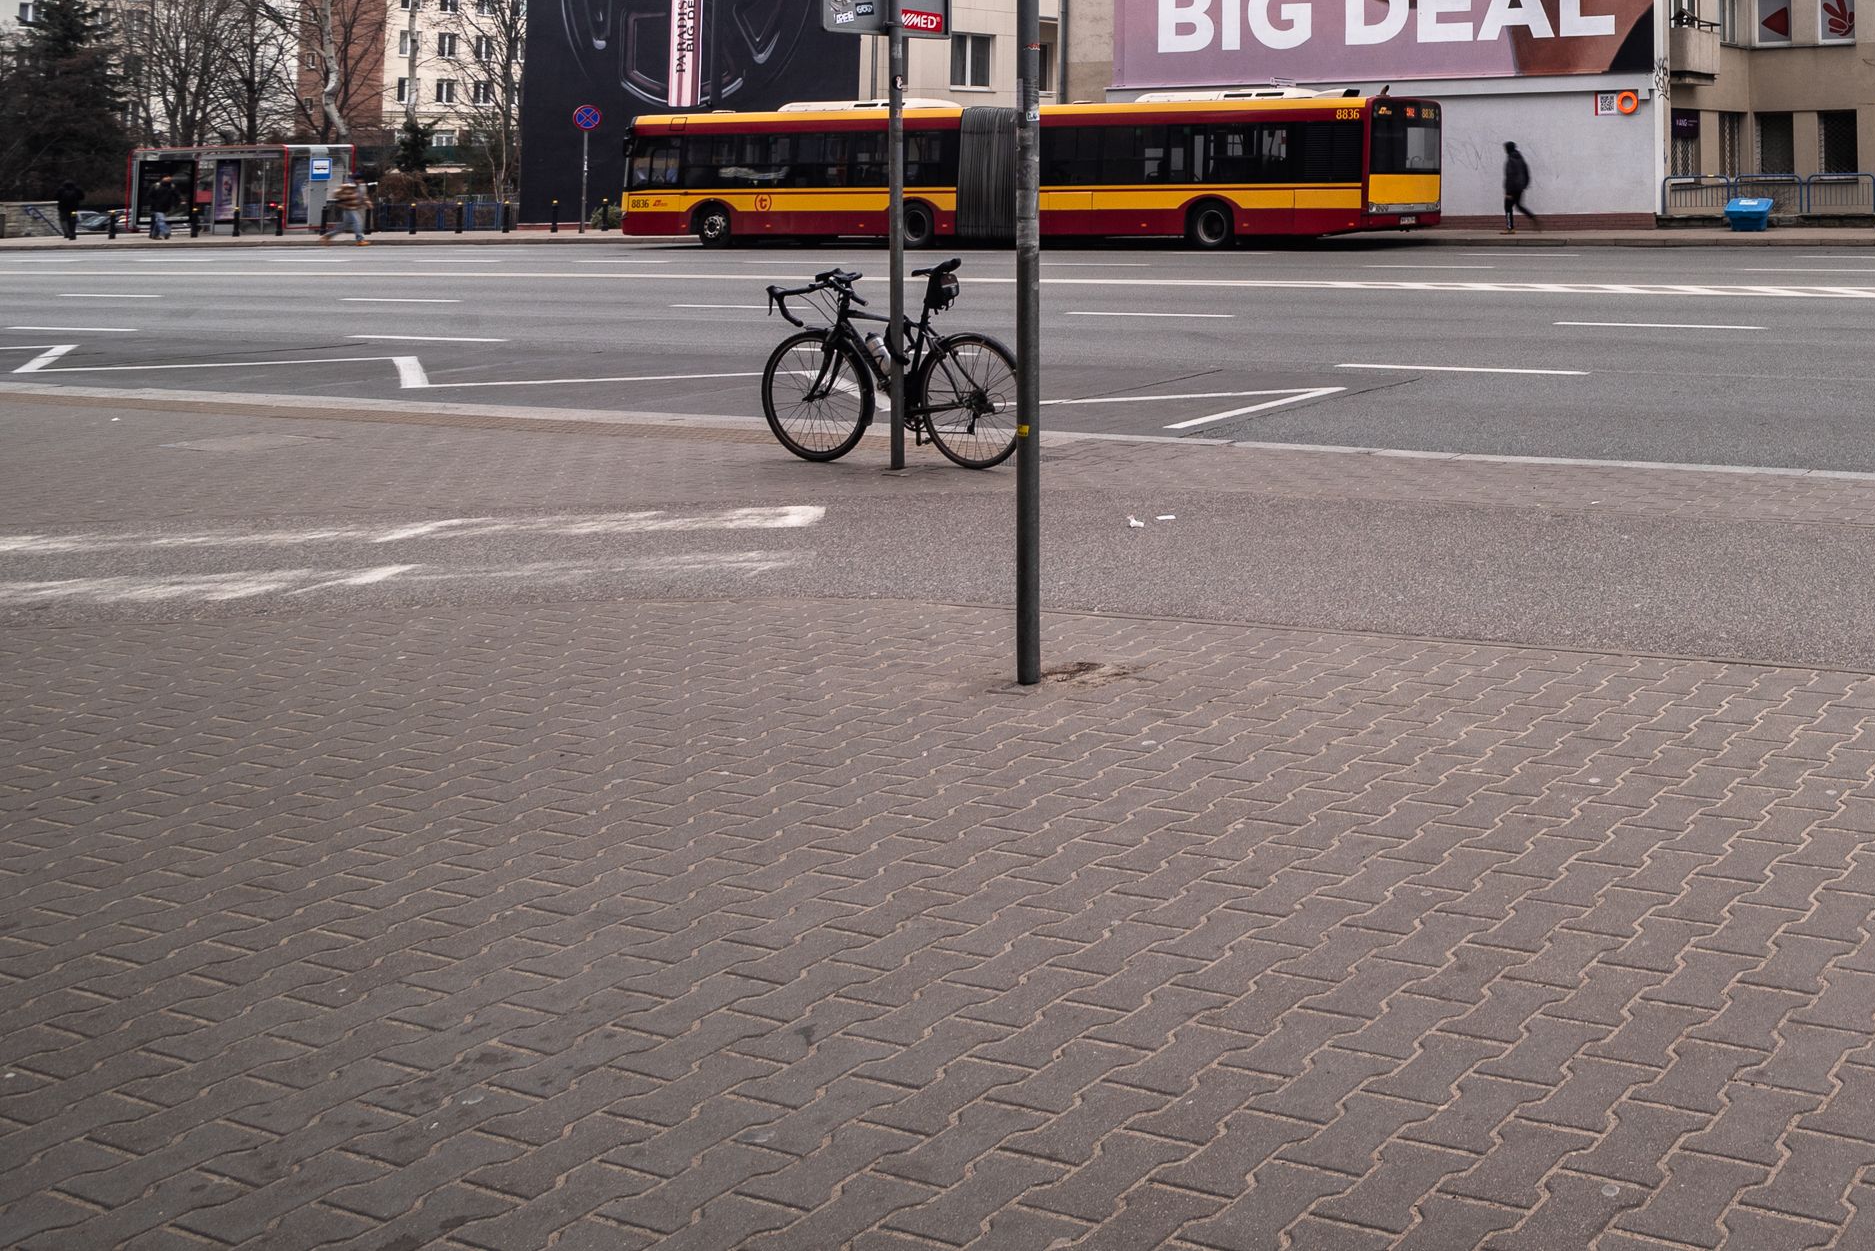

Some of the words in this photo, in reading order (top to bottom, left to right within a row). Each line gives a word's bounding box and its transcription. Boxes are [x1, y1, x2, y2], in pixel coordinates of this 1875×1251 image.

[686, 24, 695, 53] BIG
[1336, 109, 1360, 120] 8836
[1421, 108, 1435, 120] 8836
[631, 199, 649, 209] 8836
